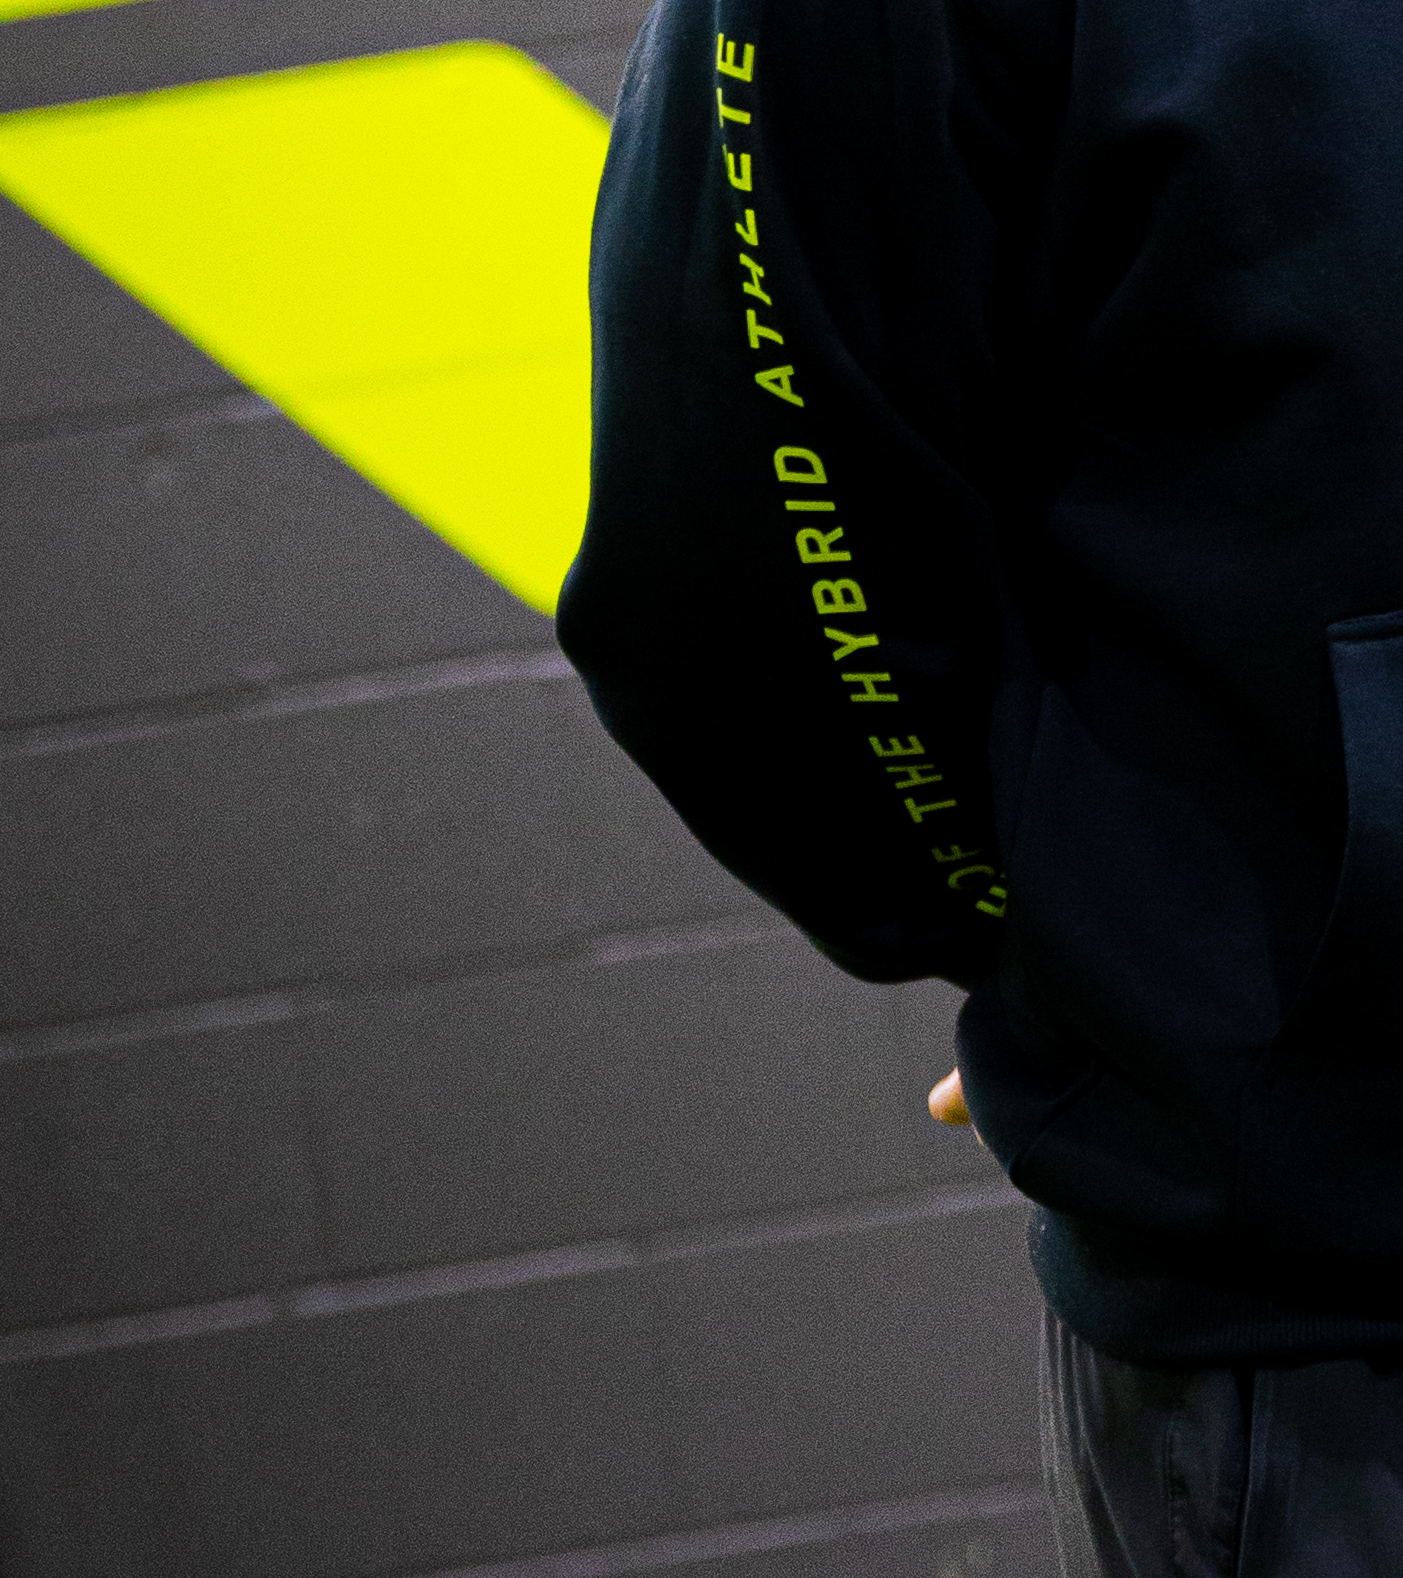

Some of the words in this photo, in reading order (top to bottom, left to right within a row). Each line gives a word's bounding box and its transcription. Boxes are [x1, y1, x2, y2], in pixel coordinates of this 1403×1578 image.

[715, 32, 805, 408] ATHLETE
[772, 444, 899, 703] HYBRID
[868, 734, 957, 823] THE
